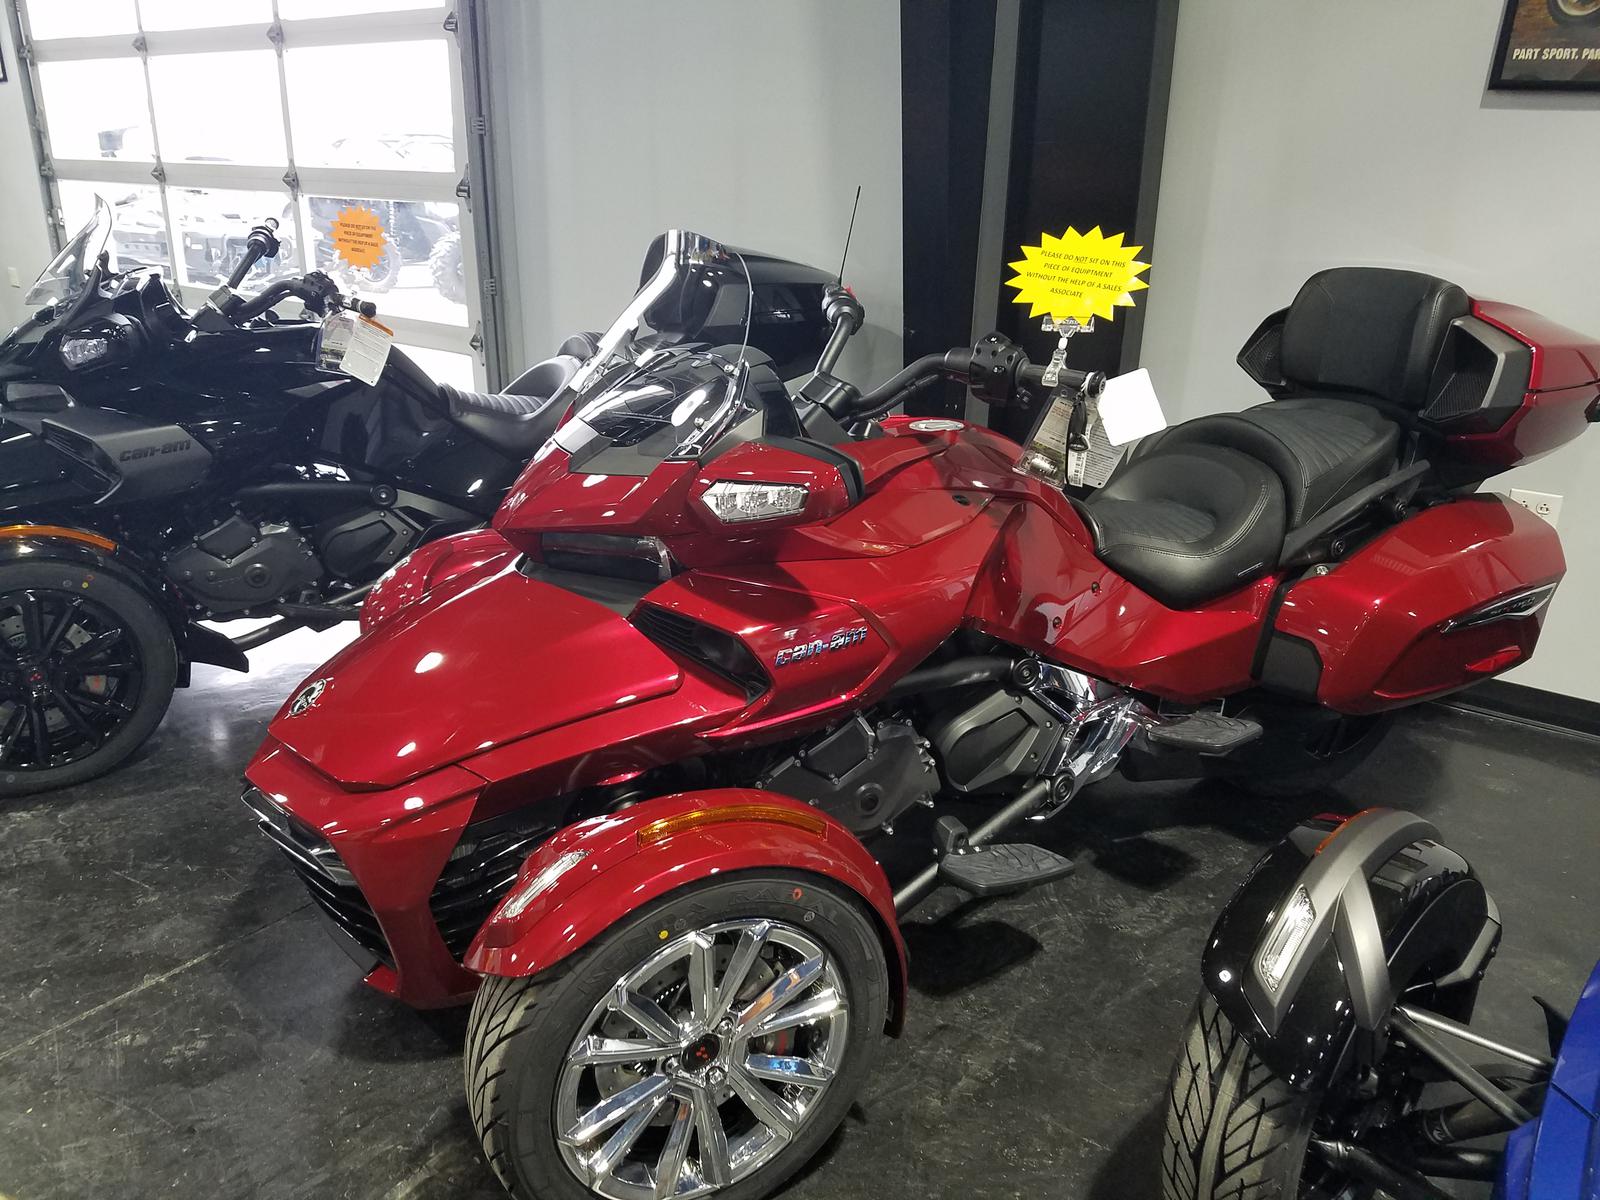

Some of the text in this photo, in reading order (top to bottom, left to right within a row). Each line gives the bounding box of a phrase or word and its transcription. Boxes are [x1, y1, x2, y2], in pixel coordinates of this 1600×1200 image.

[1512, 47, 1541, 60] PART
[1541, 47, 1578, 60] SPORT.
[1040, 250, 1063, 259] PLEASE
[1074, 255, 1088, 263] NOT
[1111, 260, 1126, 268] THIS
[1043, 262, 1061, 270] PIECE
[1071, 266, 1113, 278] EQUIPTMENT
[1026, 271, 1056, 281] WITHOUT
[1057, 276, 1069, 284] THE
[1070, 278, 1086, 286] HELP
[1102, 283, 1122, 292] SALES
[1049, 288, 1084, 298] ASSOCIATE
[119, 440, 191, 462] can-am
[775, 626, 868, 666] can-am
